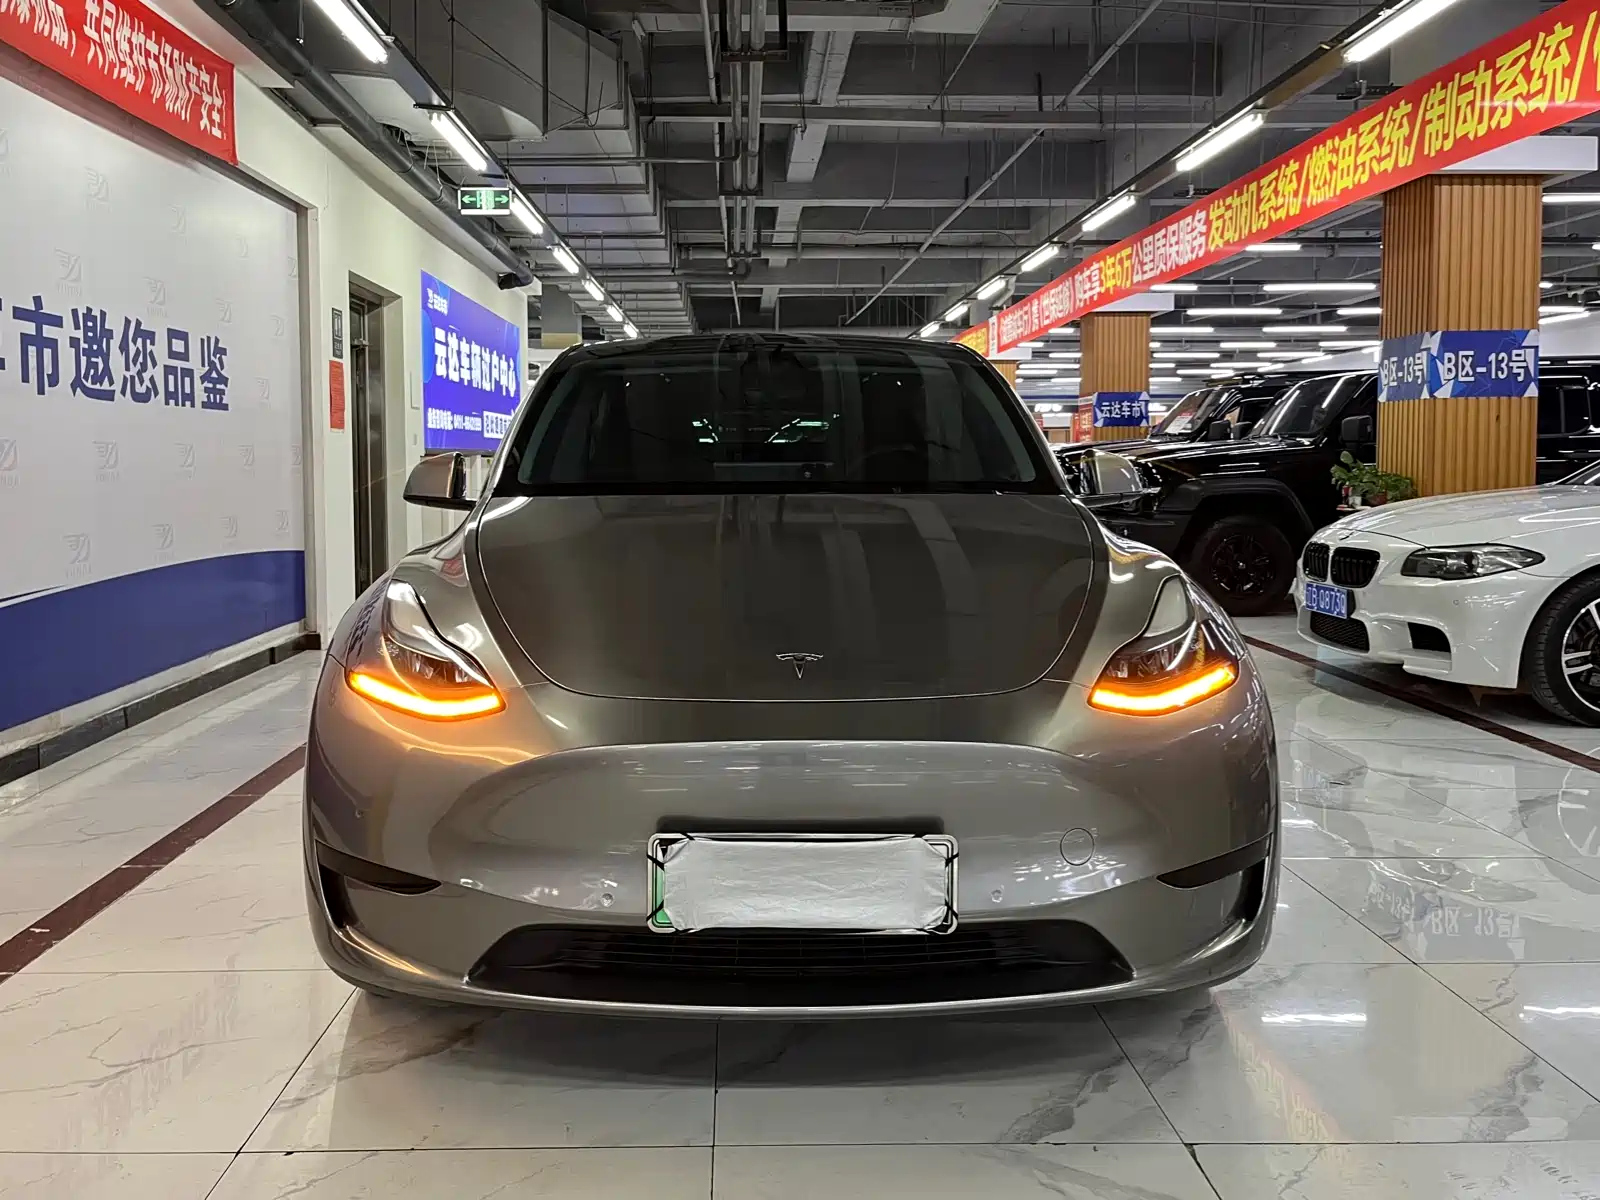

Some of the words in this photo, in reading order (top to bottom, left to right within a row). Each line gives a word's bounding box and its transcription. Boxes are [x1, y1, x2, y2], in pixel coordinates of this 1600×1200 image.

[0, 296, 230, 411] 市邀您品鉴
[1382, 353, 1424, 388] B区-13号
[1443, 349, 1528, 382] B区-13号
[1101, 400, 1142, 418] 云达车市
